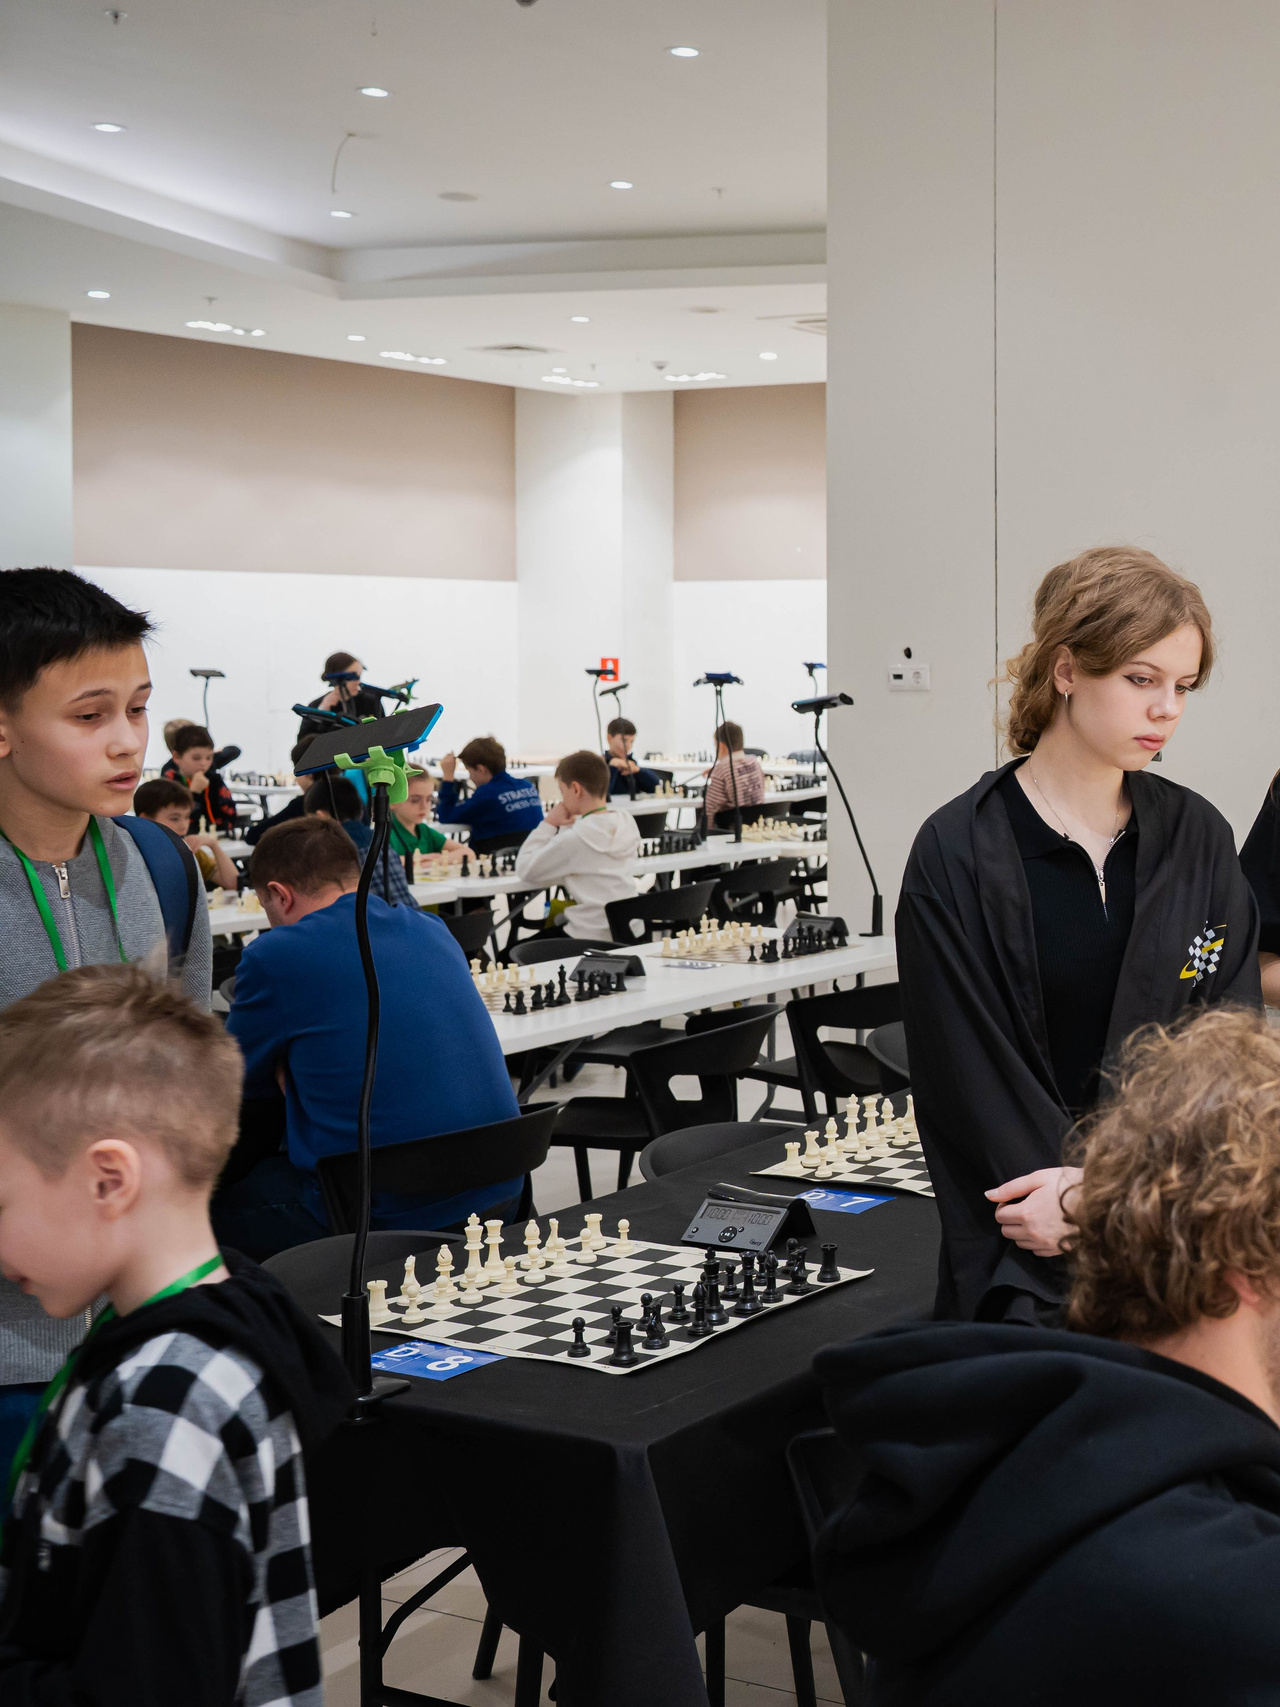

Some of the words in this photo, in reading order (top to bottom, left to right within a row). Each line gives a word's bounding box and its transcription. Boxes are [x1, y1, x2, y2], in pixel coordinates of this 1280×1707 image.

[840, 1196, 876, 1207] 7
[384, 1346, 421, 1358] D
[426, 1355, 474, 1371] 8
